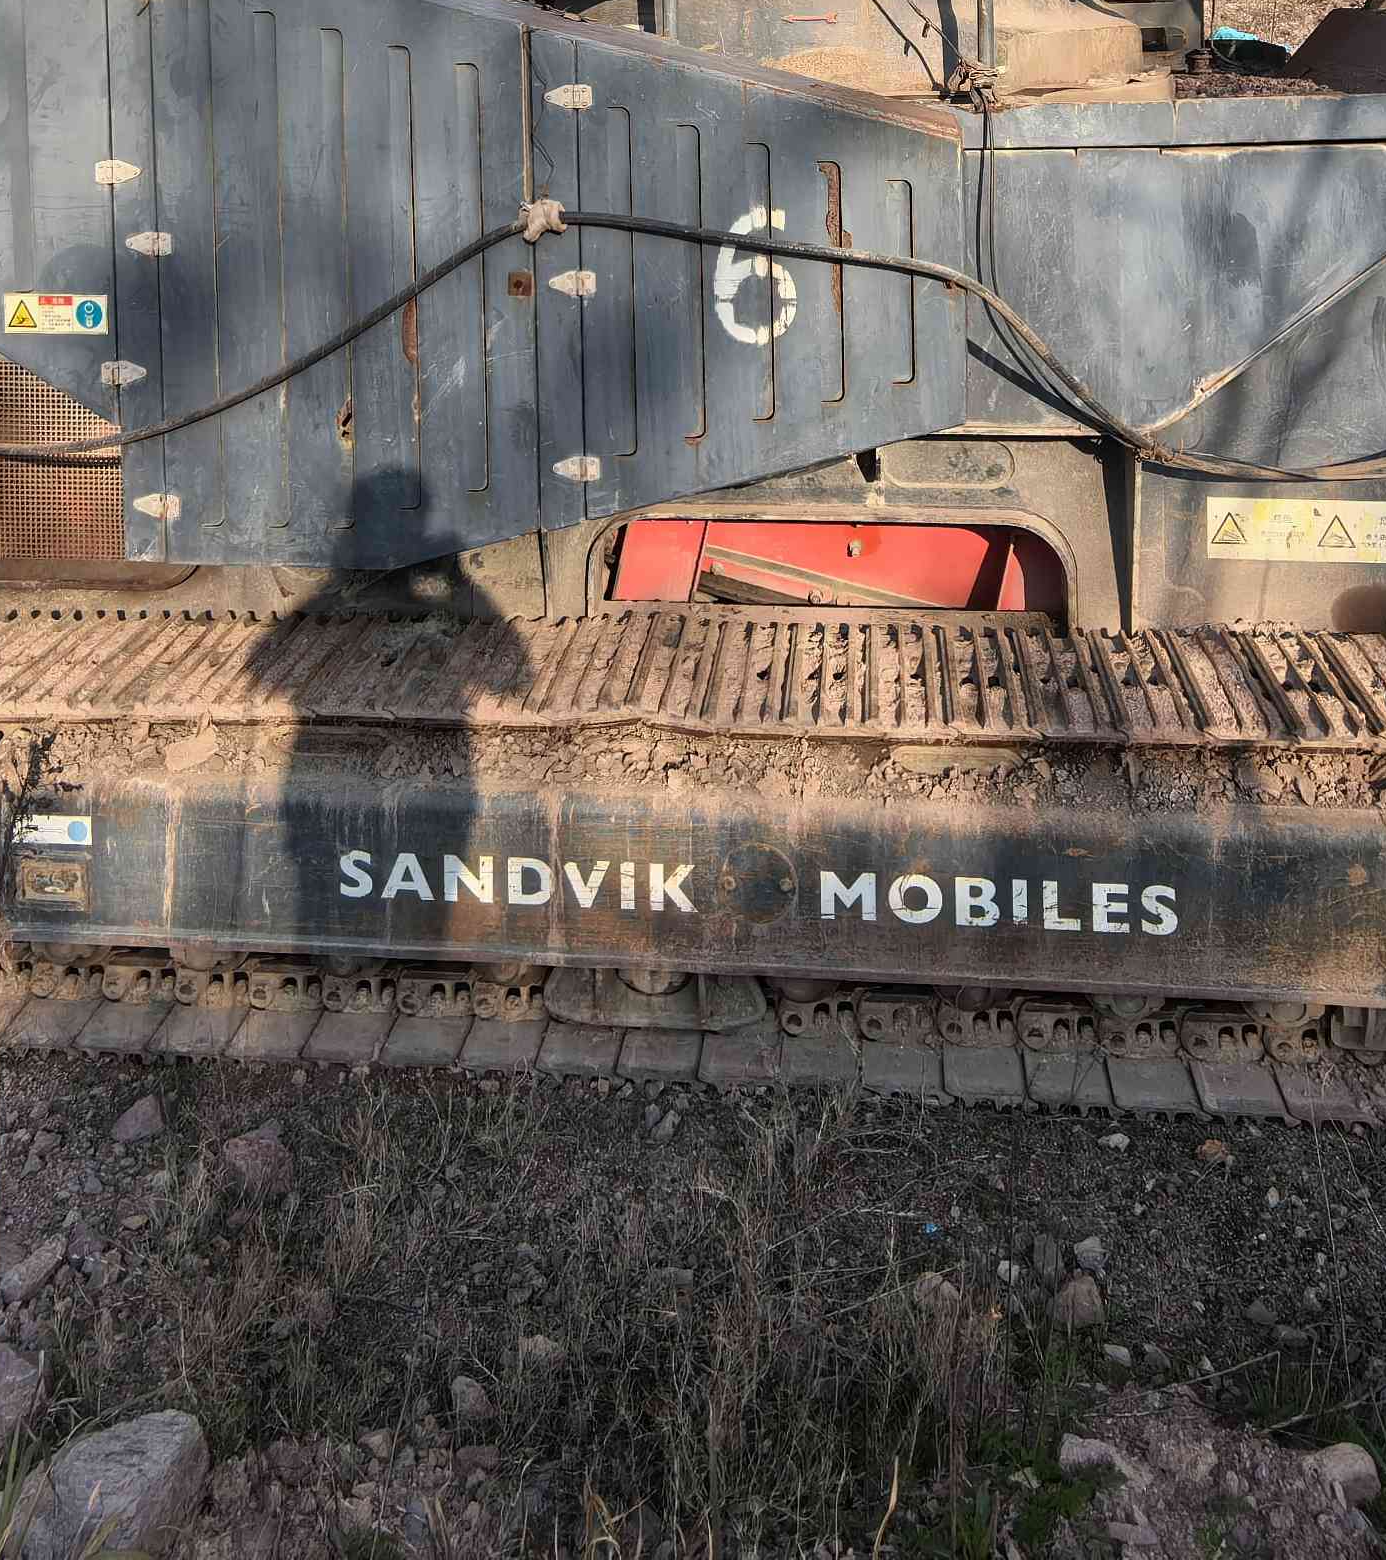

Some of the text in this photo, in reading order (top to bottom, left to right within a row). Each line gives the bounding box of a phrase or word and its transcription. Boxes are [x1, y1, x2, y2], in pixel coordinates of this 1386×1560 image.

[714, 206, 798, 345] 6
[339, 850, 1179, 936] SANDVIK MOBILES
